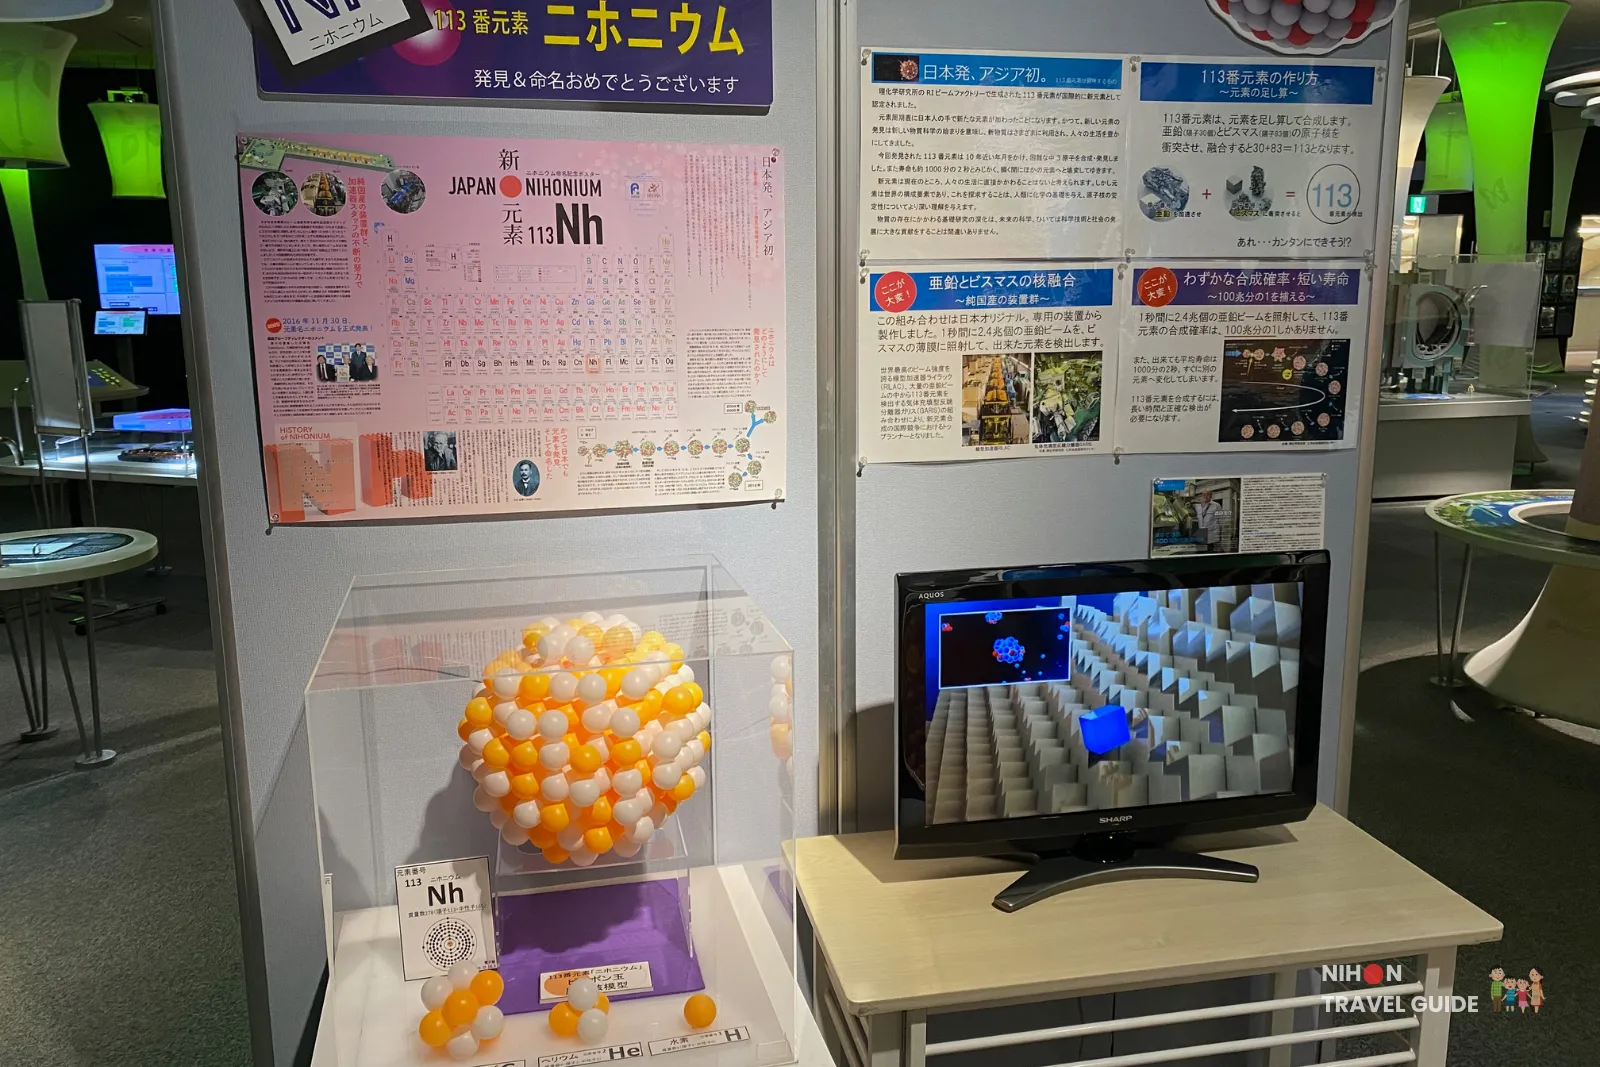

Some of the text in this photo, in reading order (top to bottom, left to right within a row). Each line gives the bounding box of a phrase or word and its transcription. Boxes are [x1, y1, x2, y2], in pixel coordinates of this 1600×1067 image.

[309, 13, 384, 51] ニホニウム
[544, 2, 744, 56] ニホニウム
[924, 65, 1047, 83] 日本発、アジア初。
[1201, 70, 1318, 86] 113番元素の作り方
[1163, 113, 1351, 126] 113番元素は、元素を足し算して合成します。
[448, 176, 496, 196] JAPAN
[525, 178, 602, 198] NIHONIUM
[1313, 184, 1352, 208] 113
[555, 203, 604, 245] Nh
[929, 273, 1076, 290] 亜鉛とビスマスの核融合
[1184, 271, 1349, 287] わずかな合成確率・短い寿命
[877, 310, 1102, 326] この組み合わせは日本オリジナル。専用の装置から
[1138, 325, 1339, 336] 元素の合成確率は、100兆分の1しかありません。
[878, 338, 1104, 353] スマスの薄膜に照射して、出来た元素を検出します。
[918, 592, 944, 600] AQUOS
[1100, 815, 1132, 824] SHARP
[405, 878, 422, 888] 113
[428, 882, 464, 906] Nh
[724, 1028, 742, 1042] H
[608, 1046, 640, 1060] He
